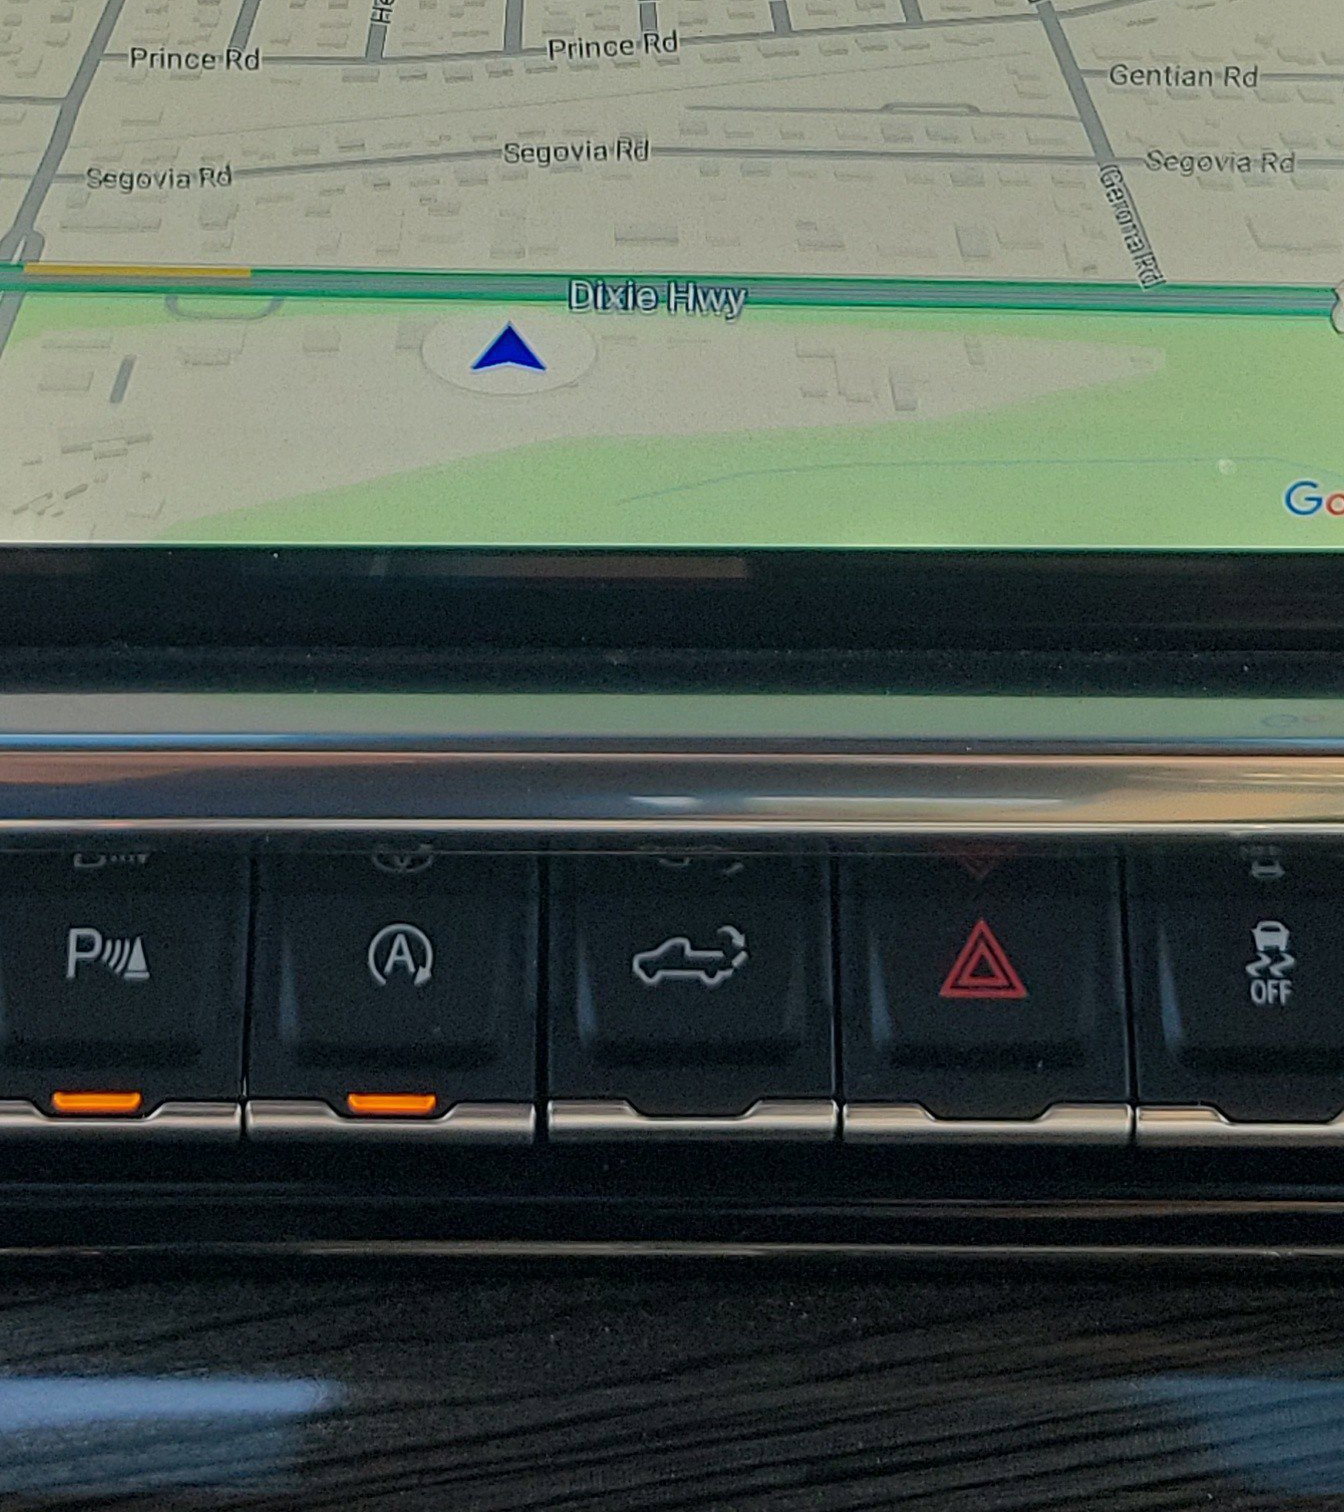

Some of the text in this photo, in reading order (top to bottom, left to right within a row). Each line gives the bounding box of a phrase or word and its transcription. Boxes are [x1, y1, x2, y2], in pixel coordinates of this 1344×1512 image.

[130, 48, 260, 71] Prince Rd
[549, 31, 679, 61] Prince Rd
[1109, 63, 1258, 88] Gentian Rd
[503, 140, 650, 168] Segovia Rd
[1145, 150, 1297, 177] Segovia Rd
[86, 164, 232, 195] Segovia Rd
[1100, 164, 1167, 289] Gerona Rd
[568, 279, 748, 320] Dixie Hwy
[1249, 979, 1292, 1007] OFF
